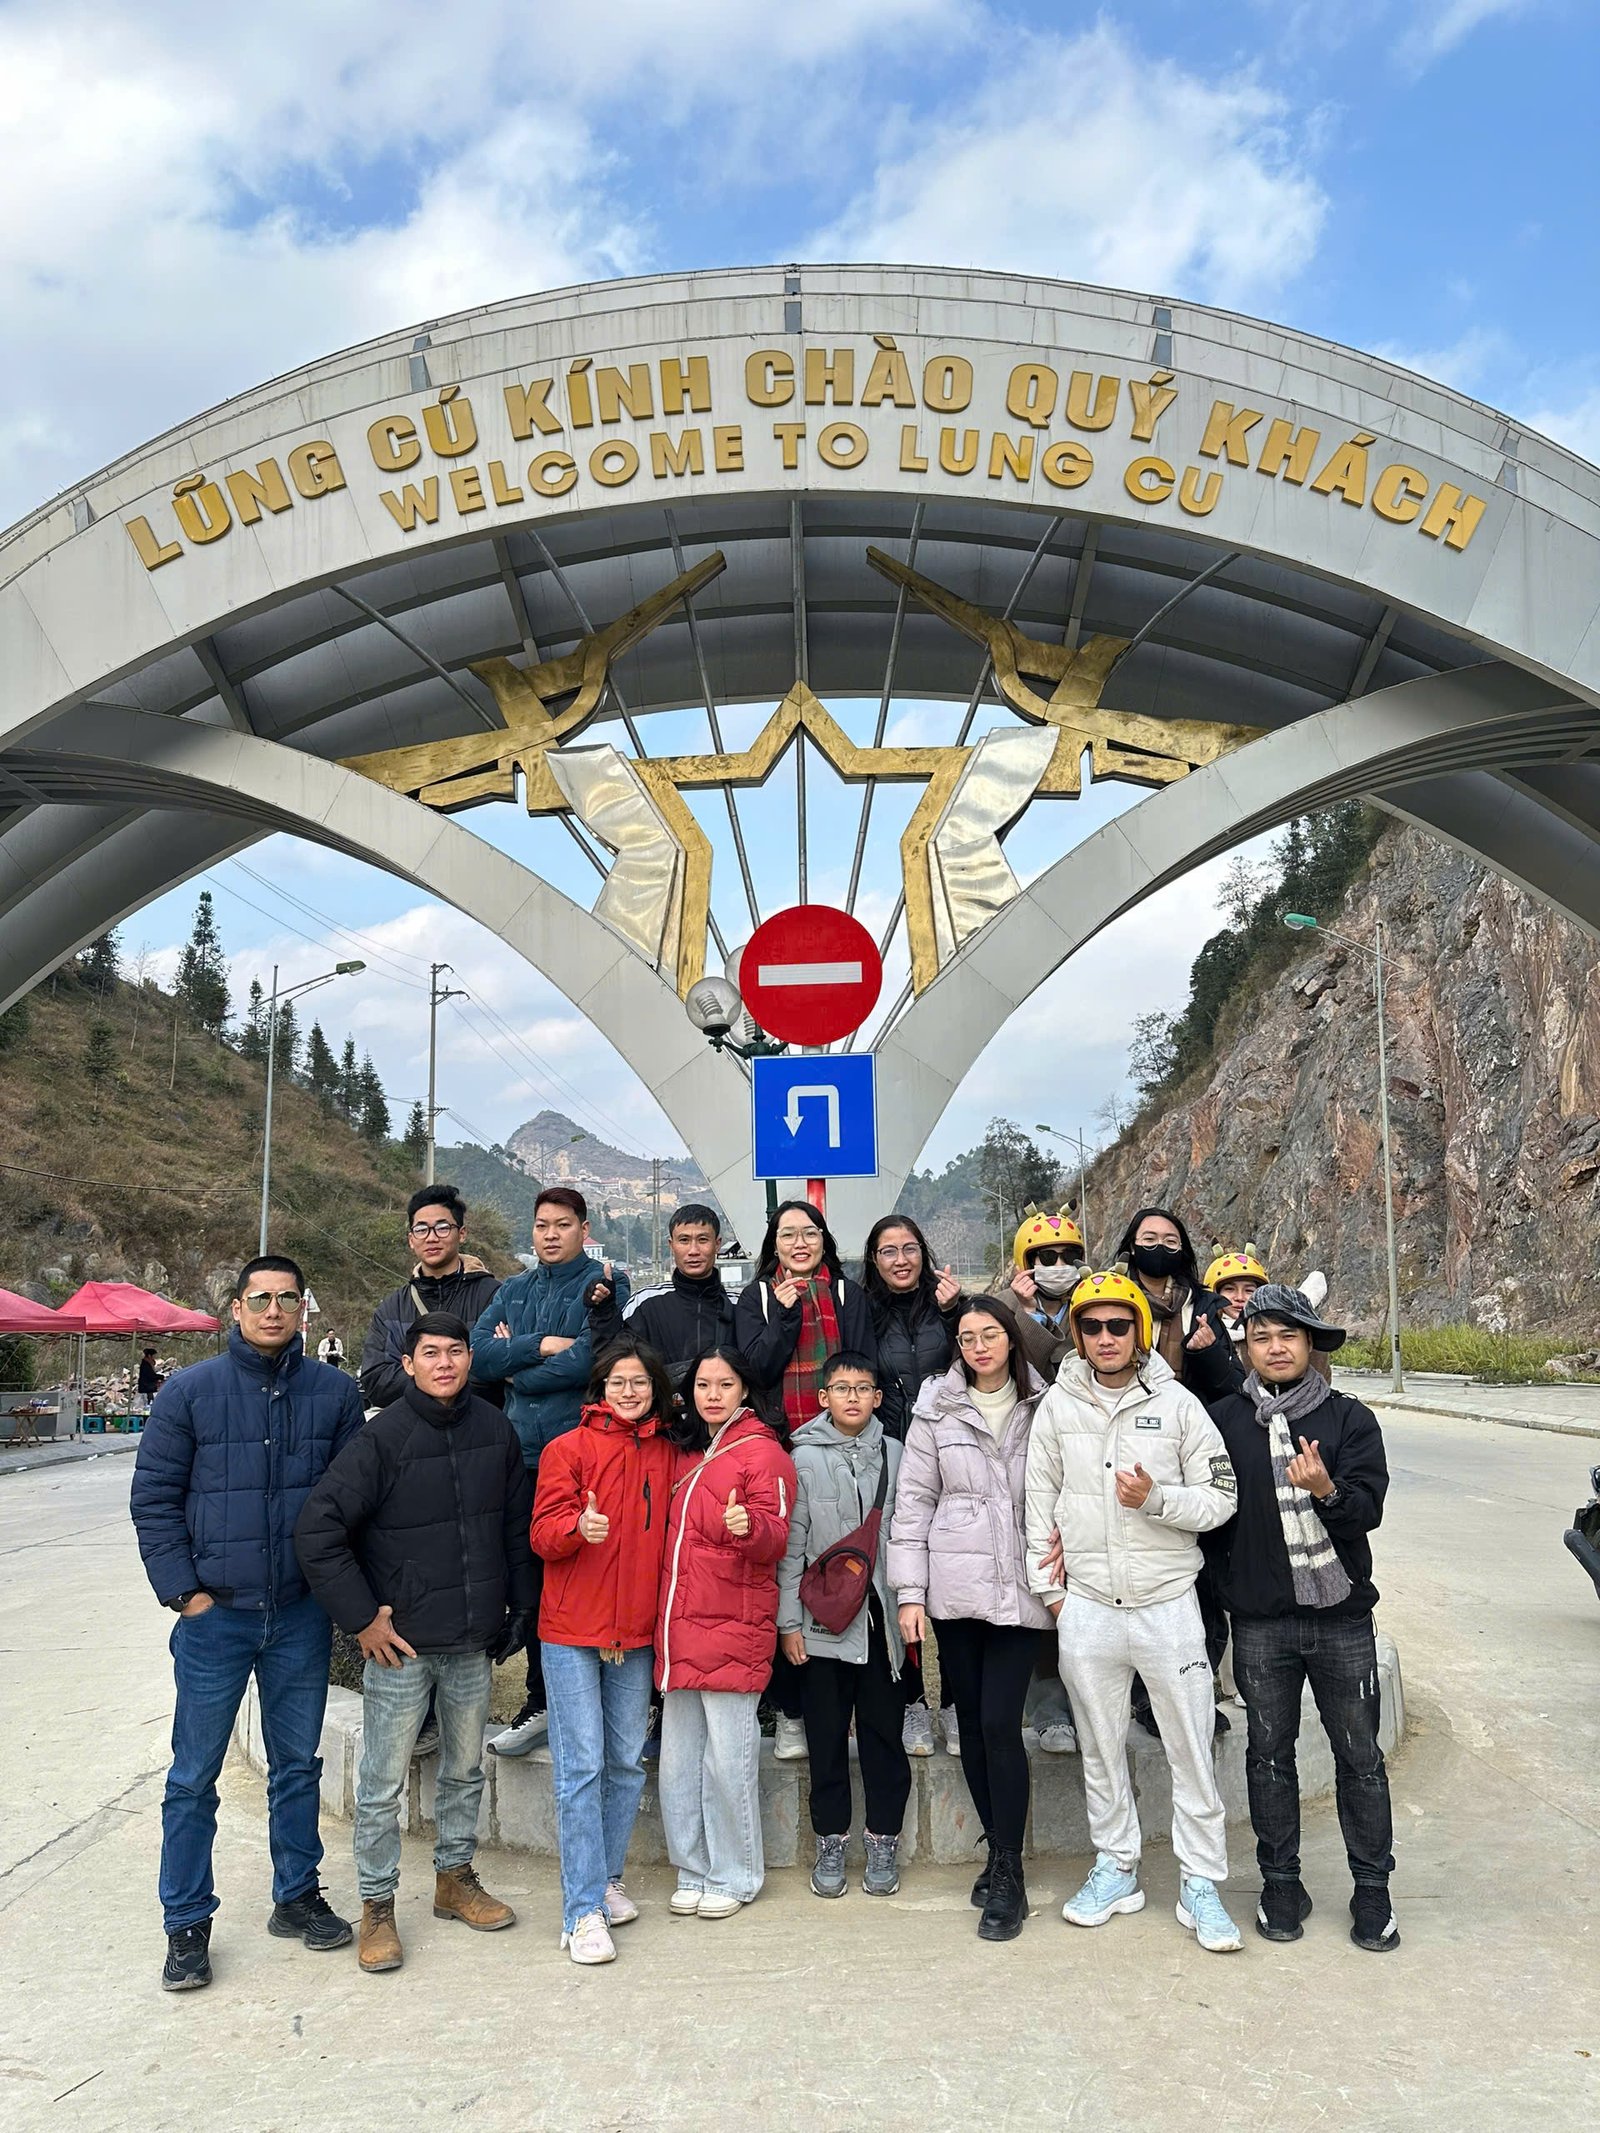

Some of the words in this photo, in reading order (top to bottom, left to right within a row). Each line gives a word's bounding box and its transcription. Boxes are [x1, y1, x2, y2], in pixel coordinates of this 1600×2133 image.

[125, 438, 348, 571] LŨNG
[366, 385, 478, 472] CÚ
[503, 355, 712, 441] KÍNH
[744, 334, 973, 414] CHÀO
[1006, 362, 1179, 442] QUÝ
[1199, 400, 1487, 551] KHÁCH
[380, 424, 745, 532] WELCOME
[773, 421, 869, 470] TO
[899, 425, 1095, 489] LUNG
[1123, 455, 1224, 518] CU
